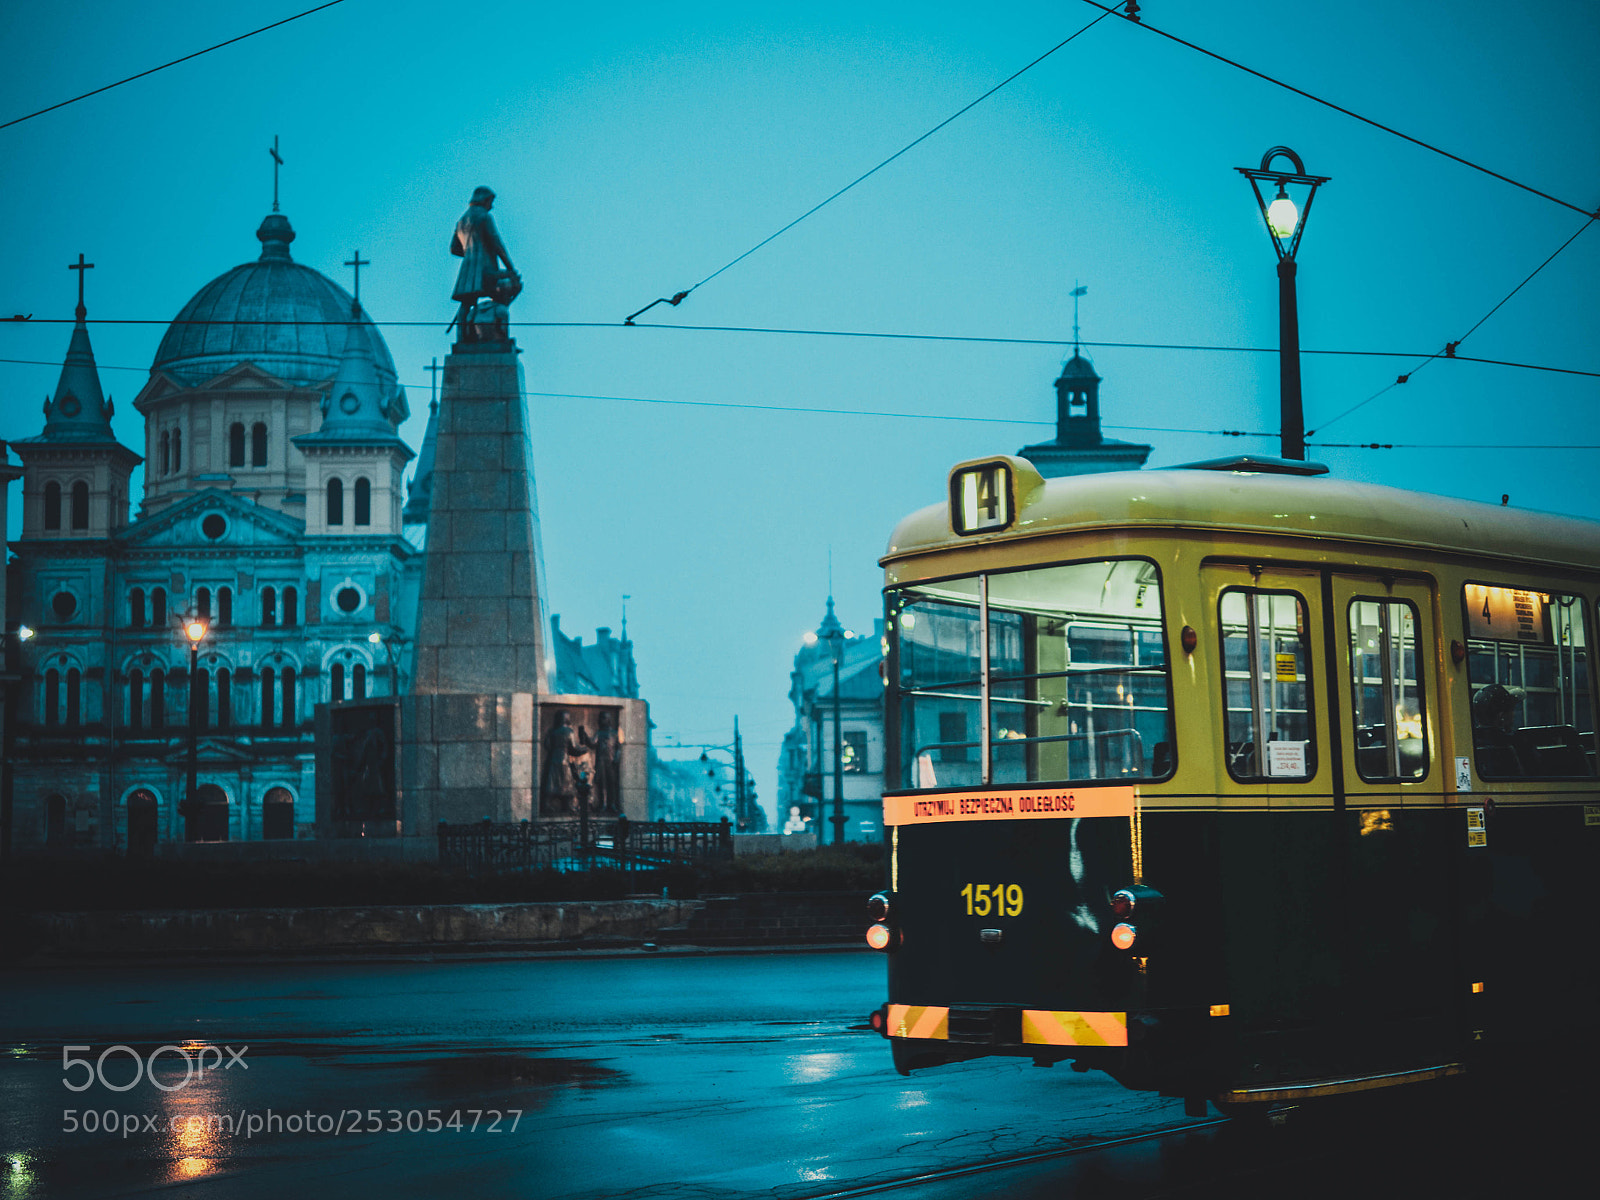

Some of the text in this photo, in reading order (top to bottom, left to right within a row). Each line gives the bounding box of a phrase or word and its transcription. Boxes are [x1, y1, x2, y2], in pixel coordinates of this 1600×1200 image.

[978, 469, 999, 520] 4
[1482, 596, 1492, 625] 4
[913, 792, 1076, 817] UTRZYMUJ BEZPIECZNĄ ODLEGŁOŚĆ
[960, 883, 1024, 917] 1519
